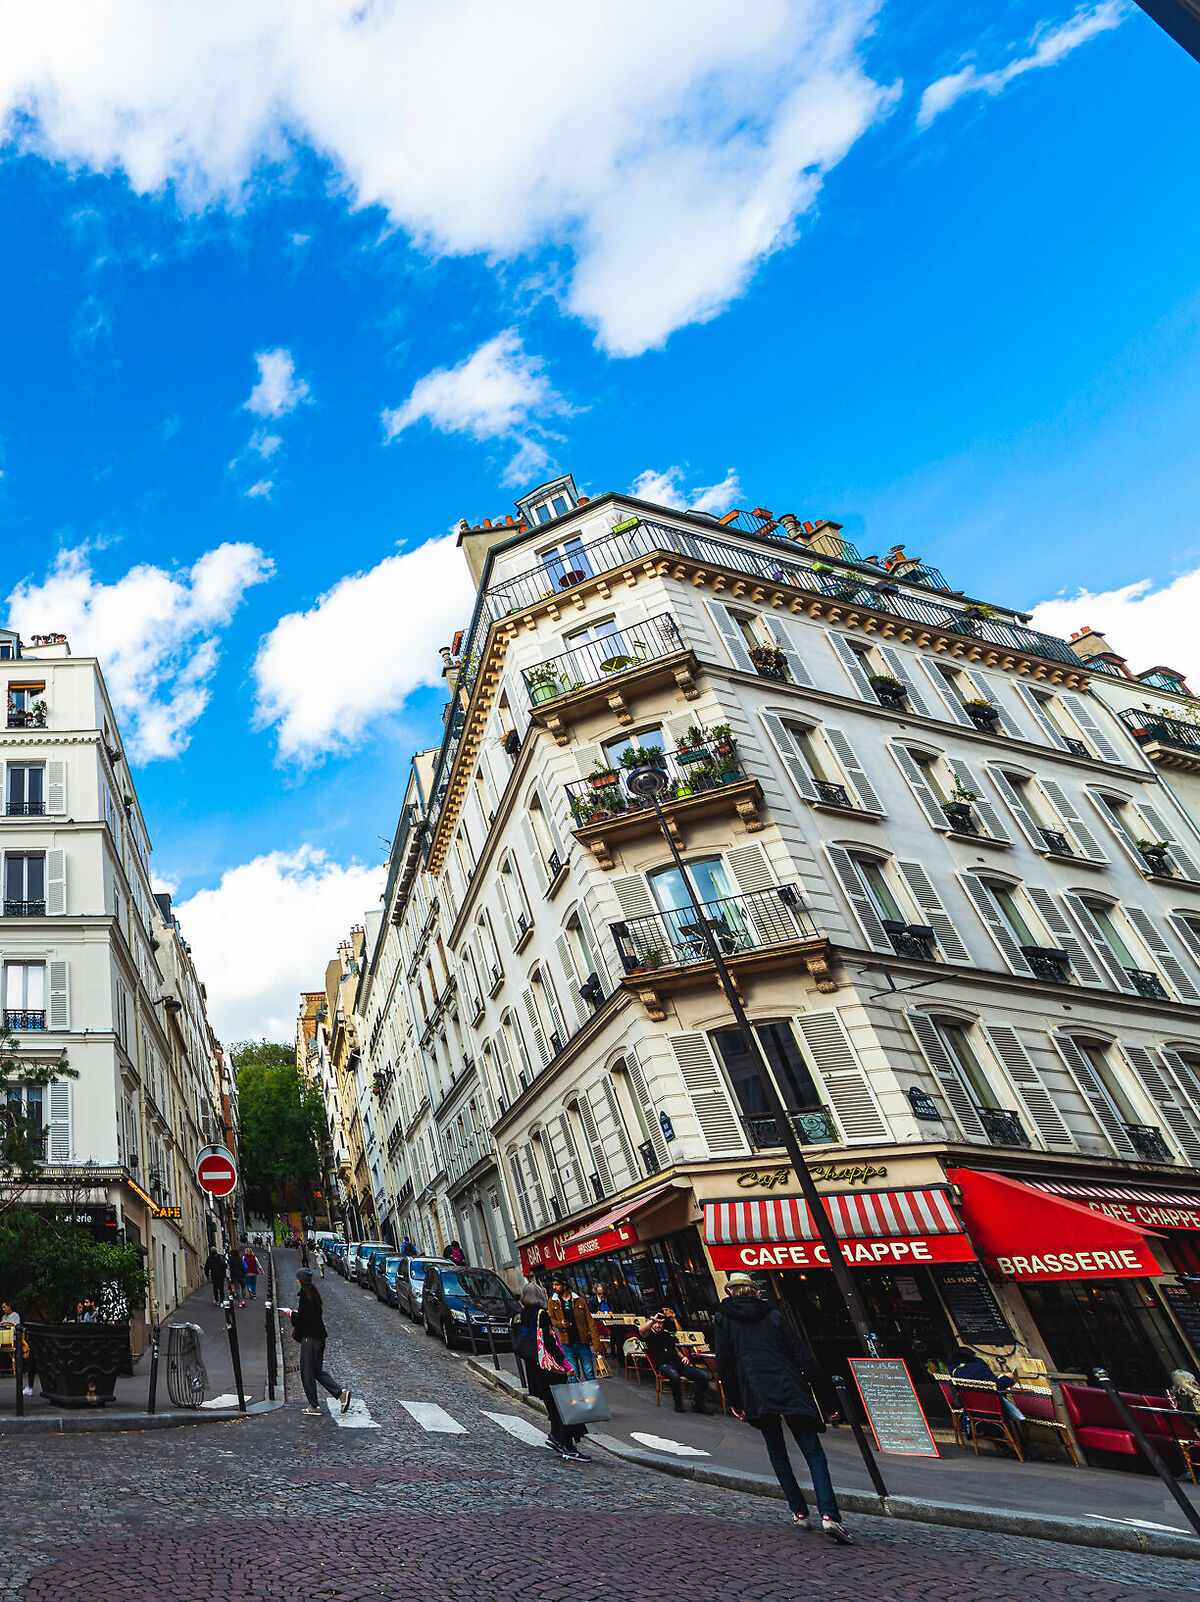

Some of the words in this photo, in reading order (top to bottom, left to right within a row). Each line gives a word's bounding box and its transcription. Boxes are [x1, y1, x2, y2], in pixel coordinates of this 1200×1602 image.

[736, 1168, 790, 1189] Café
[808, 1163, 888, 1185] Chappe
[152, 1207, 181, 1218] CAFE
[1135, 1205, 1200, 1228] CHAPPE
[527, 1244, 541, 1265] BAR
[577, 1239, 600, 1255] BRASSERIE
[740, 1246, 810, 1266] CAFE
[814, 1242, 933, 1264] CHAPPE
[997, 1250, 1143, 1275] BRASSERIE
